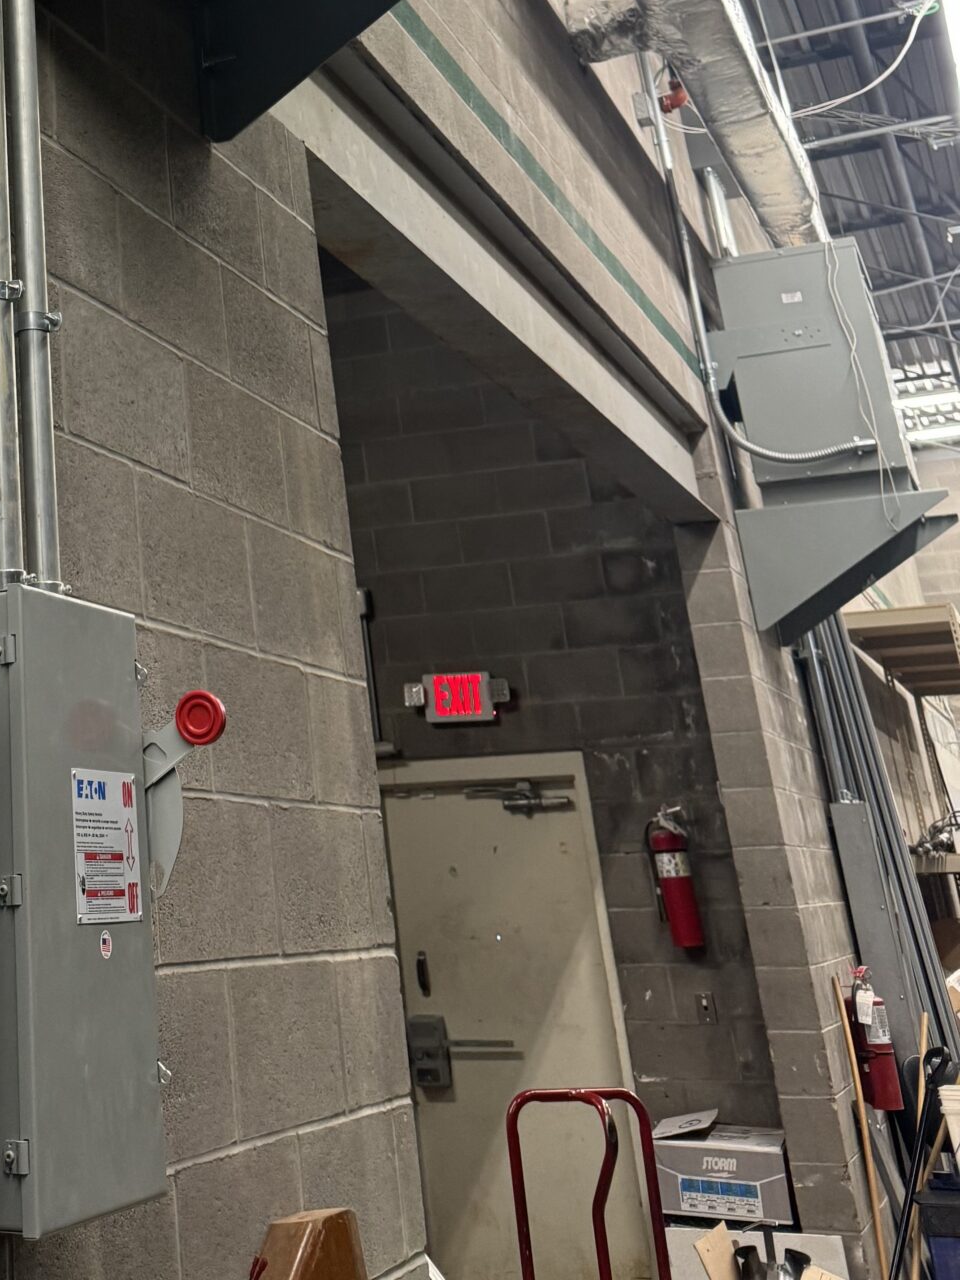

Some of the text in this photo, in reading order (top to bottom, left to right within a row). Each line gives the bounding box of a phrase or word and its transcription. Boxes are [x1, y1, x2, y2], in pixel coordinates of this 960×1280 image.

[433, 673, 482, 716] EXIT
[77, 779, 106, 800] EATON
[122, 781, 133, 808] ON
[127, 882, 138, 914] OFF
[702, 1156, 737, 1171] STORM
